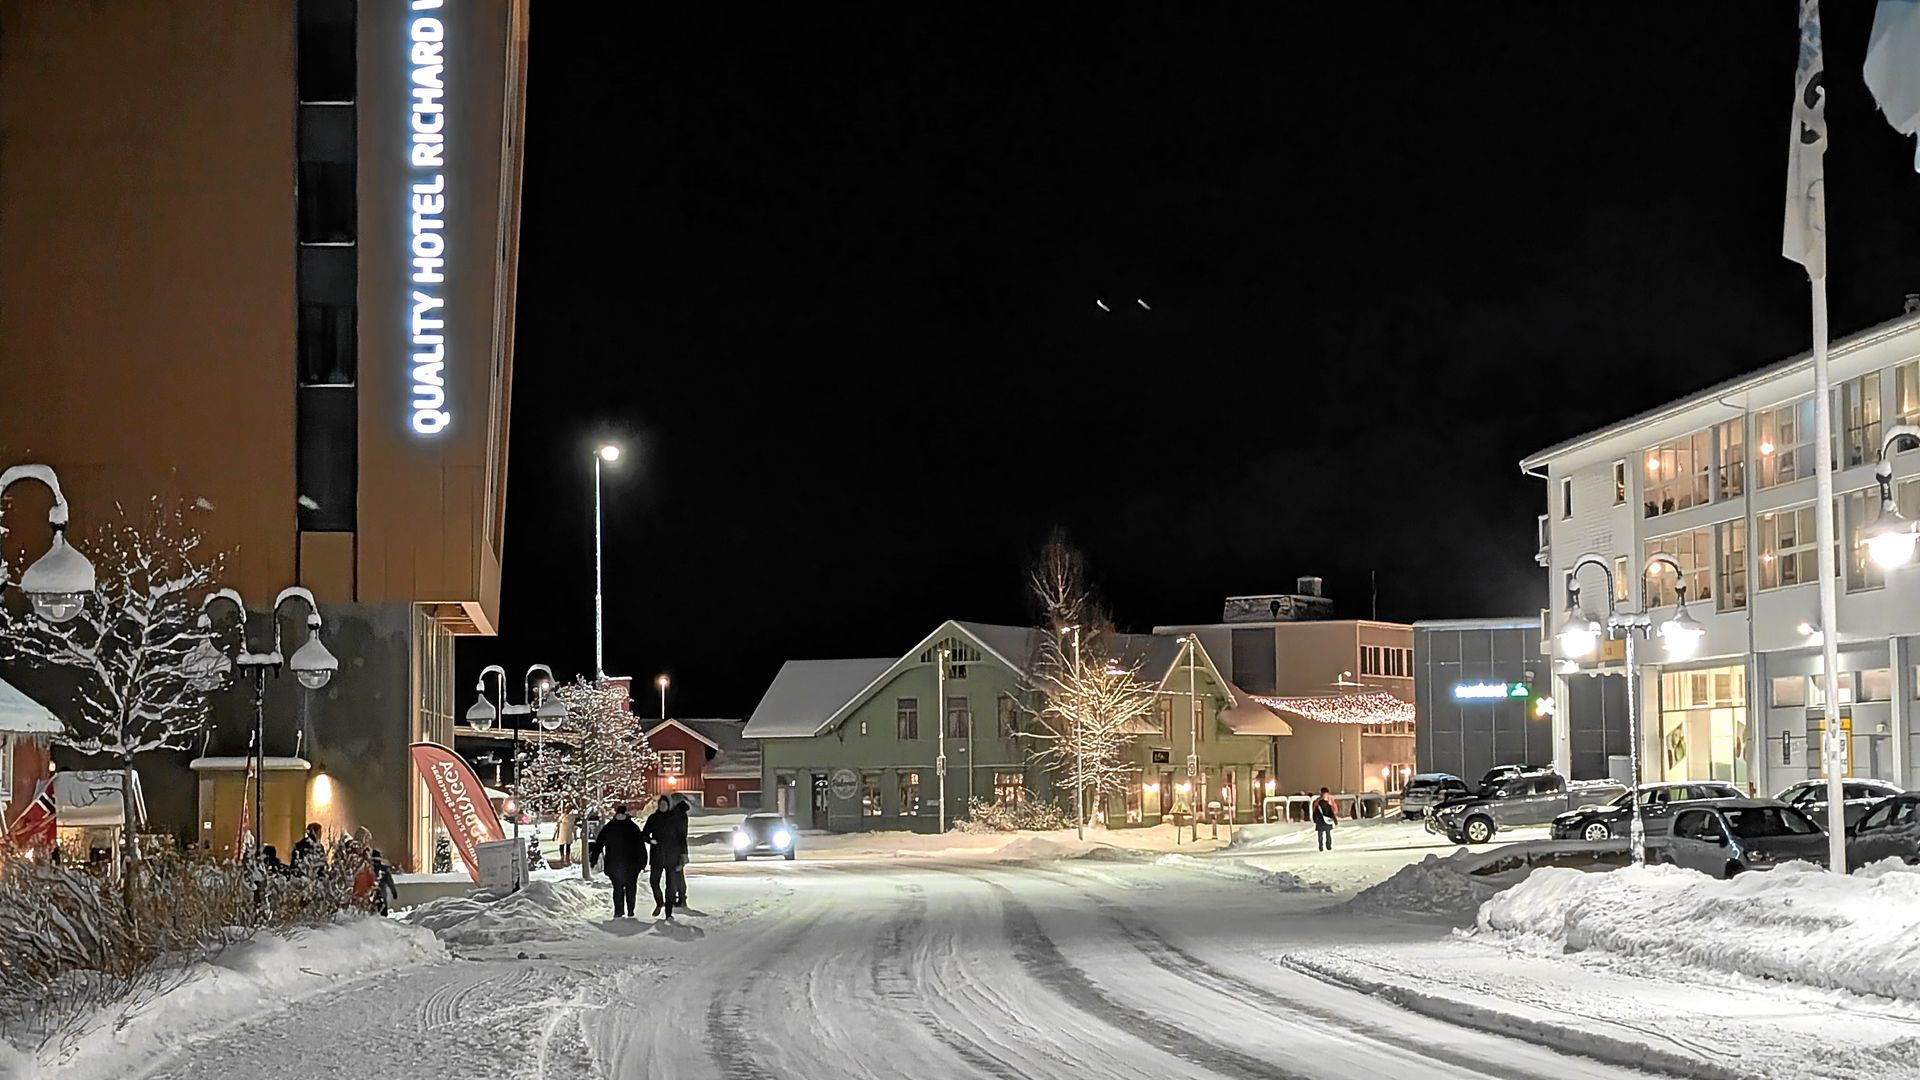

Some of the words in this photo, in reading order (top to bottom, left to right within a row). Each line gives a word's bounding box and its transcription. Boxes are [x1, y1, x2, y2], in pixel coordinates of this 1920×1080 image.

[412, 17, 444, 166] RICHARD
[412, 175, 445, 283] HOTEL
[412, 291, 450, 435] QUALITY
